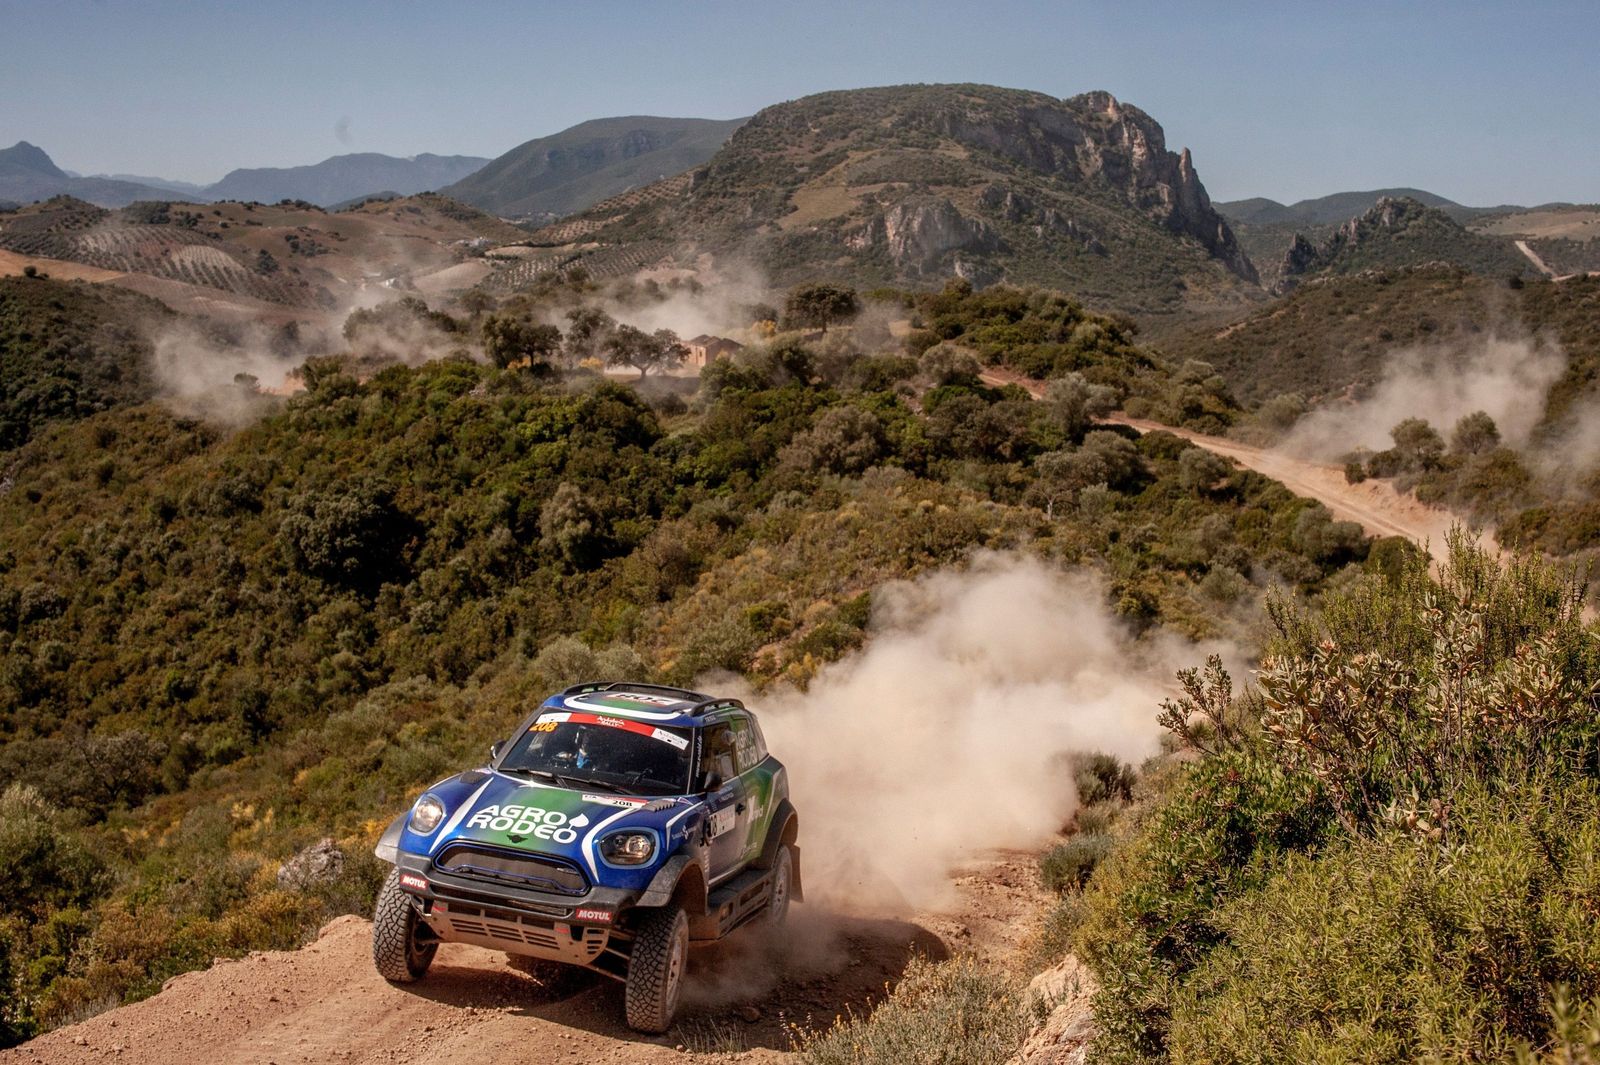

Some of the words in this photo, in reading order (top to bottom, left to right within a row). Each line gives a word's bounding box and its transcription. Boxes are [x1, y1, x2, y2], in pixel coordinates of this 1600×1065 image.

[528, 722, 559, 732] 208
[476, 804, 568, 826] AGRO
[466, 813, 578, 844] RODEO
[402, 875, 426, 889] MOTUL
[578, 909, 610, 921] MOTUL
